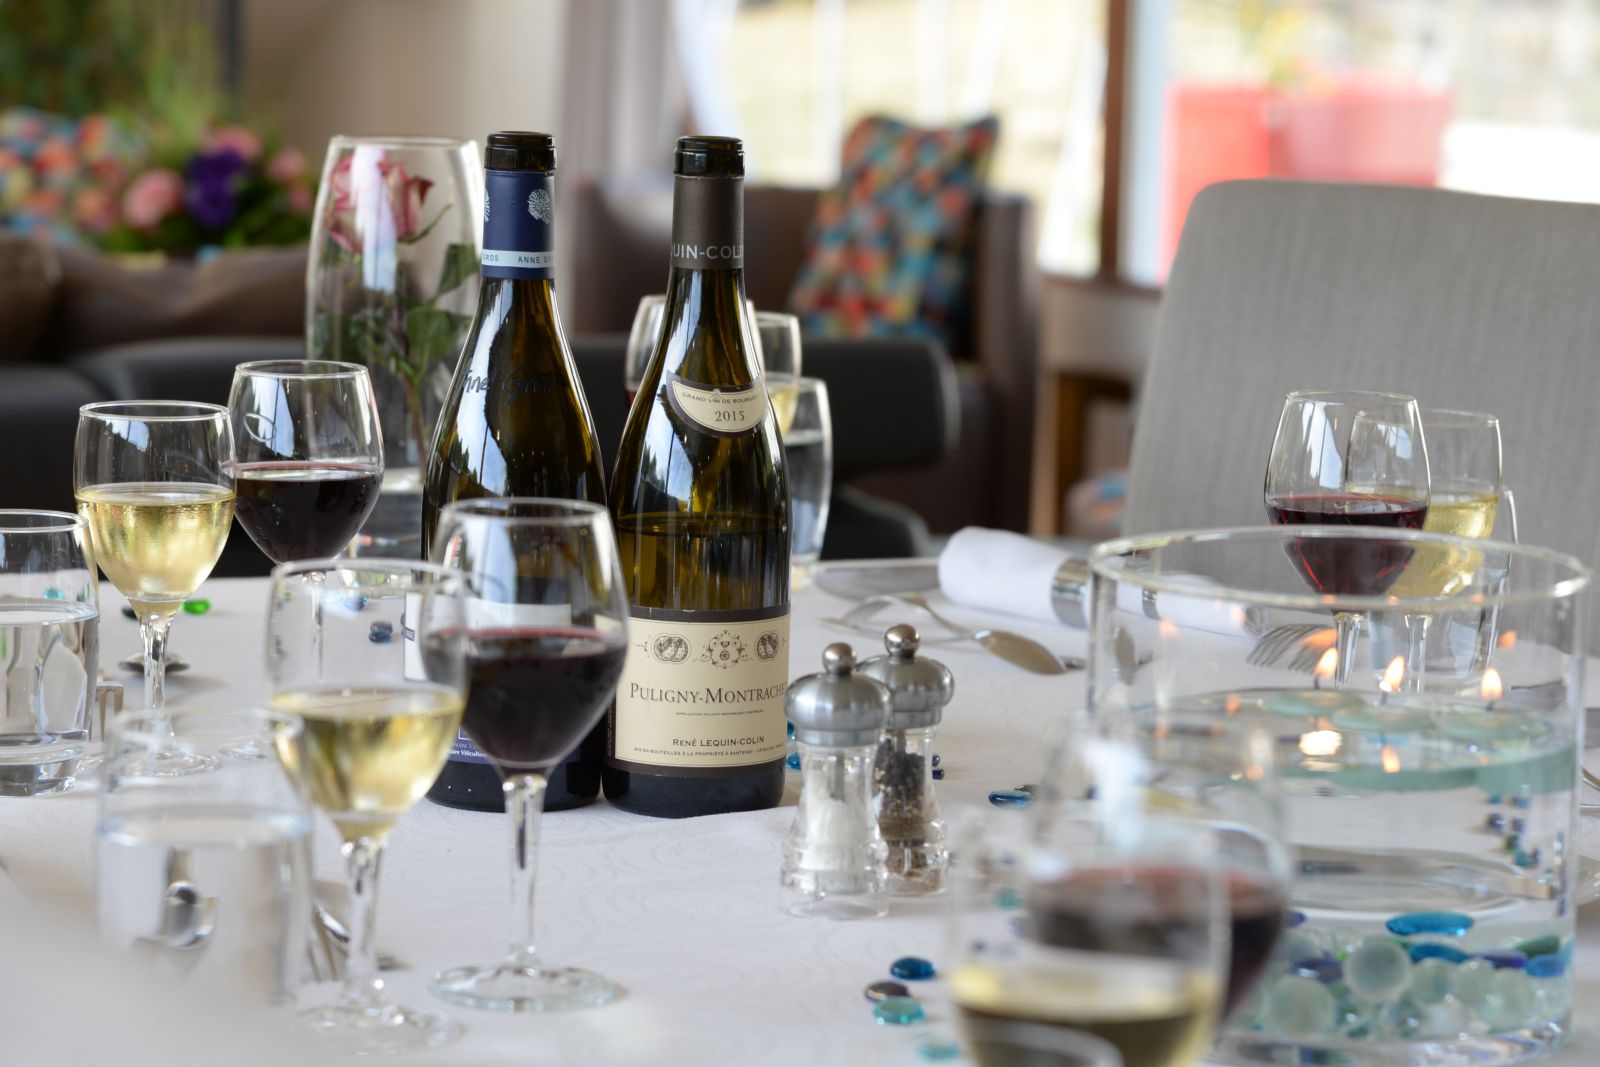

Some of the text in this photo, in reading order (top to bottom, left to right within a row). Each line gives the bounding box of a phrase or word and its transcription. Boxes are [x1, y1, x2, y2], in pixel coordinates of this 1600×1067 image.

[517, 256, 540, 264] ANNE
[682, 392, 706, 402] GRAND
[714, 411, 745, 422] 2015
[630, 682, 787, 704] PULIGNY-MONTRACHE
[672, 736, 765, 747] RENÉ LEQUIN-COLIN
